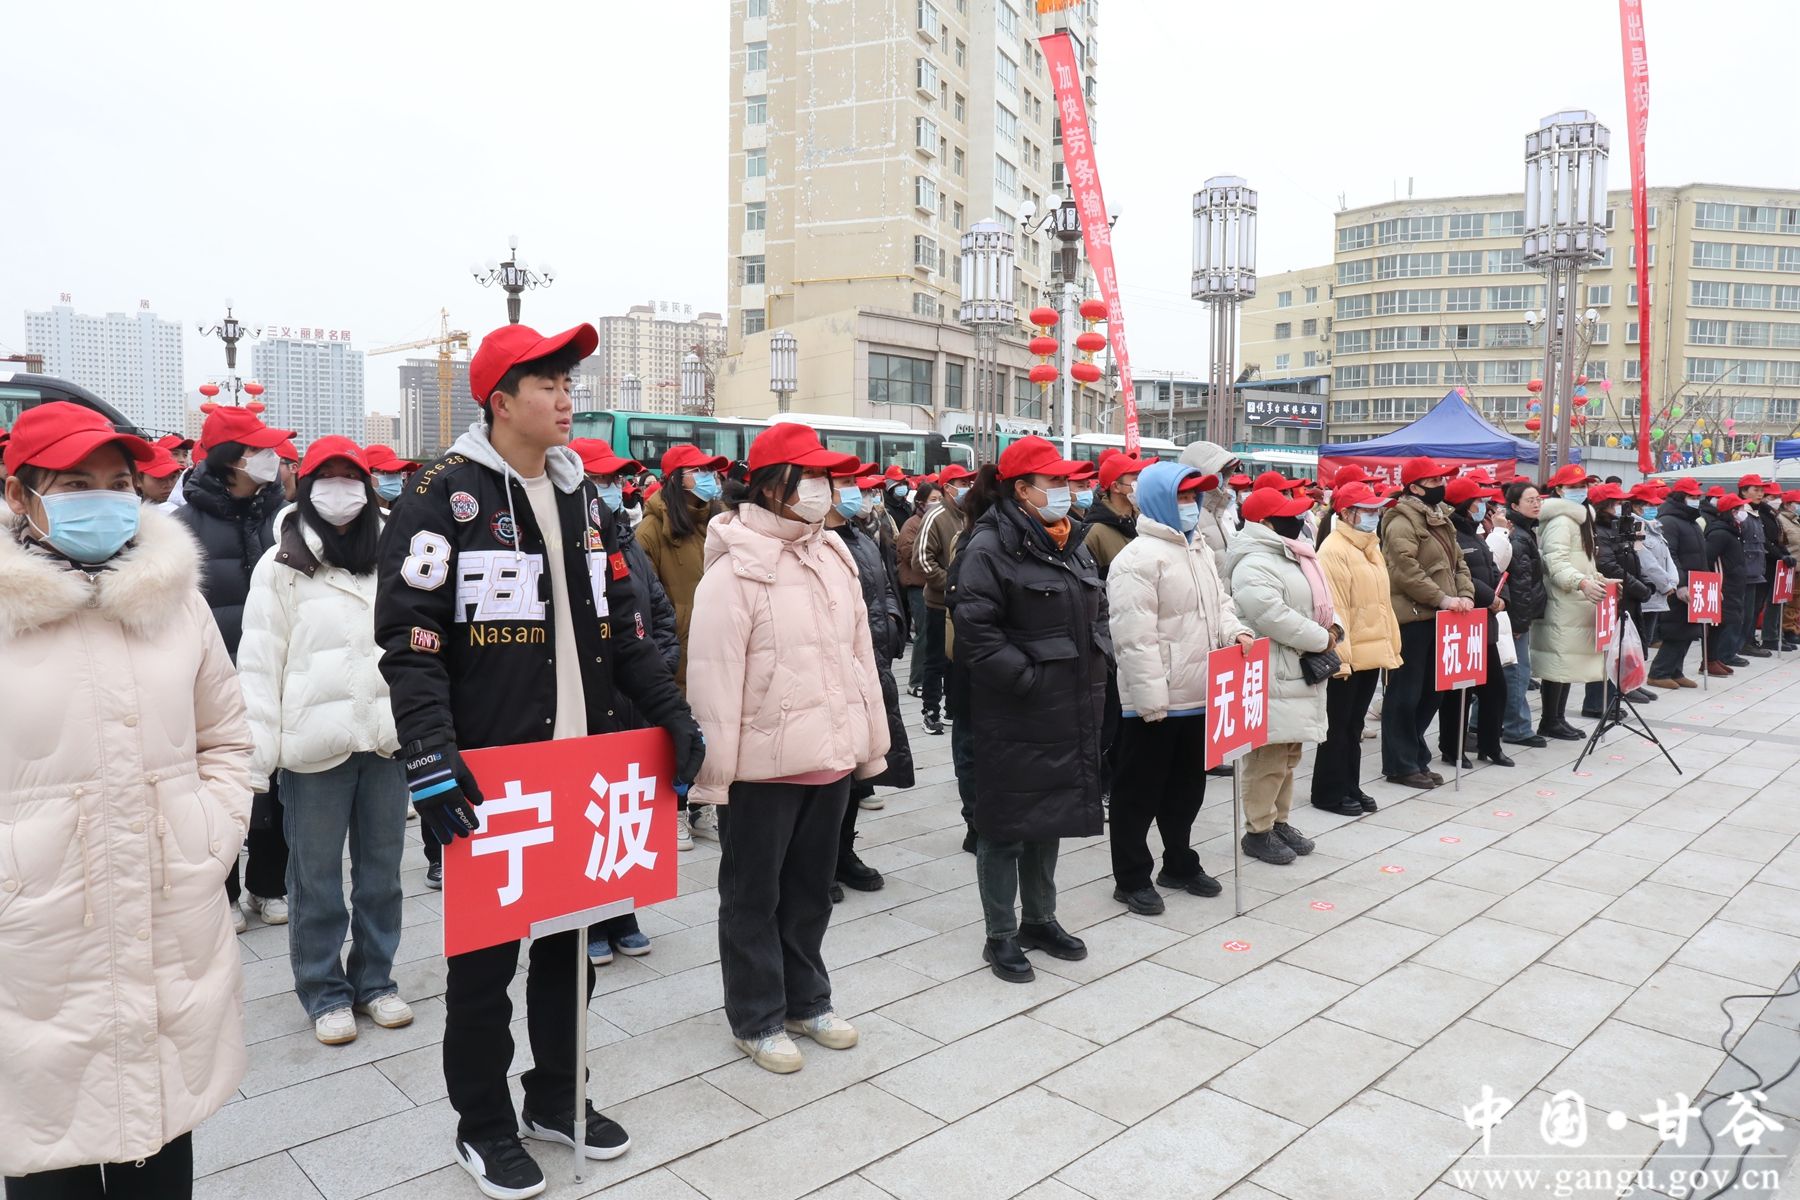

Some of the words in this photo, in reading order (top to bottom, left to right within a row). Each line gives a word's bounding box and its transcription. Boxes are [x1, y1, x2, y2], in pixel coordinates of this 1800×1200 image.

[1056, 61, 1111, 249] 加快劳务输转
[400, 529, 452, 592] 8
[1775, 567, 1795, 595] 广州
[1598, 595, 1616, 638] 上海
[1692, 580, 1719, 614] 苏州
[470, 624, 545, 646] Nasam
[1442, 623, 1483, 676] 杭州
[1213, 659, 1263, 744] 无锡
[455, 807, 474, 829] SPORTS
[471, 762, 659, 908] 宁波
